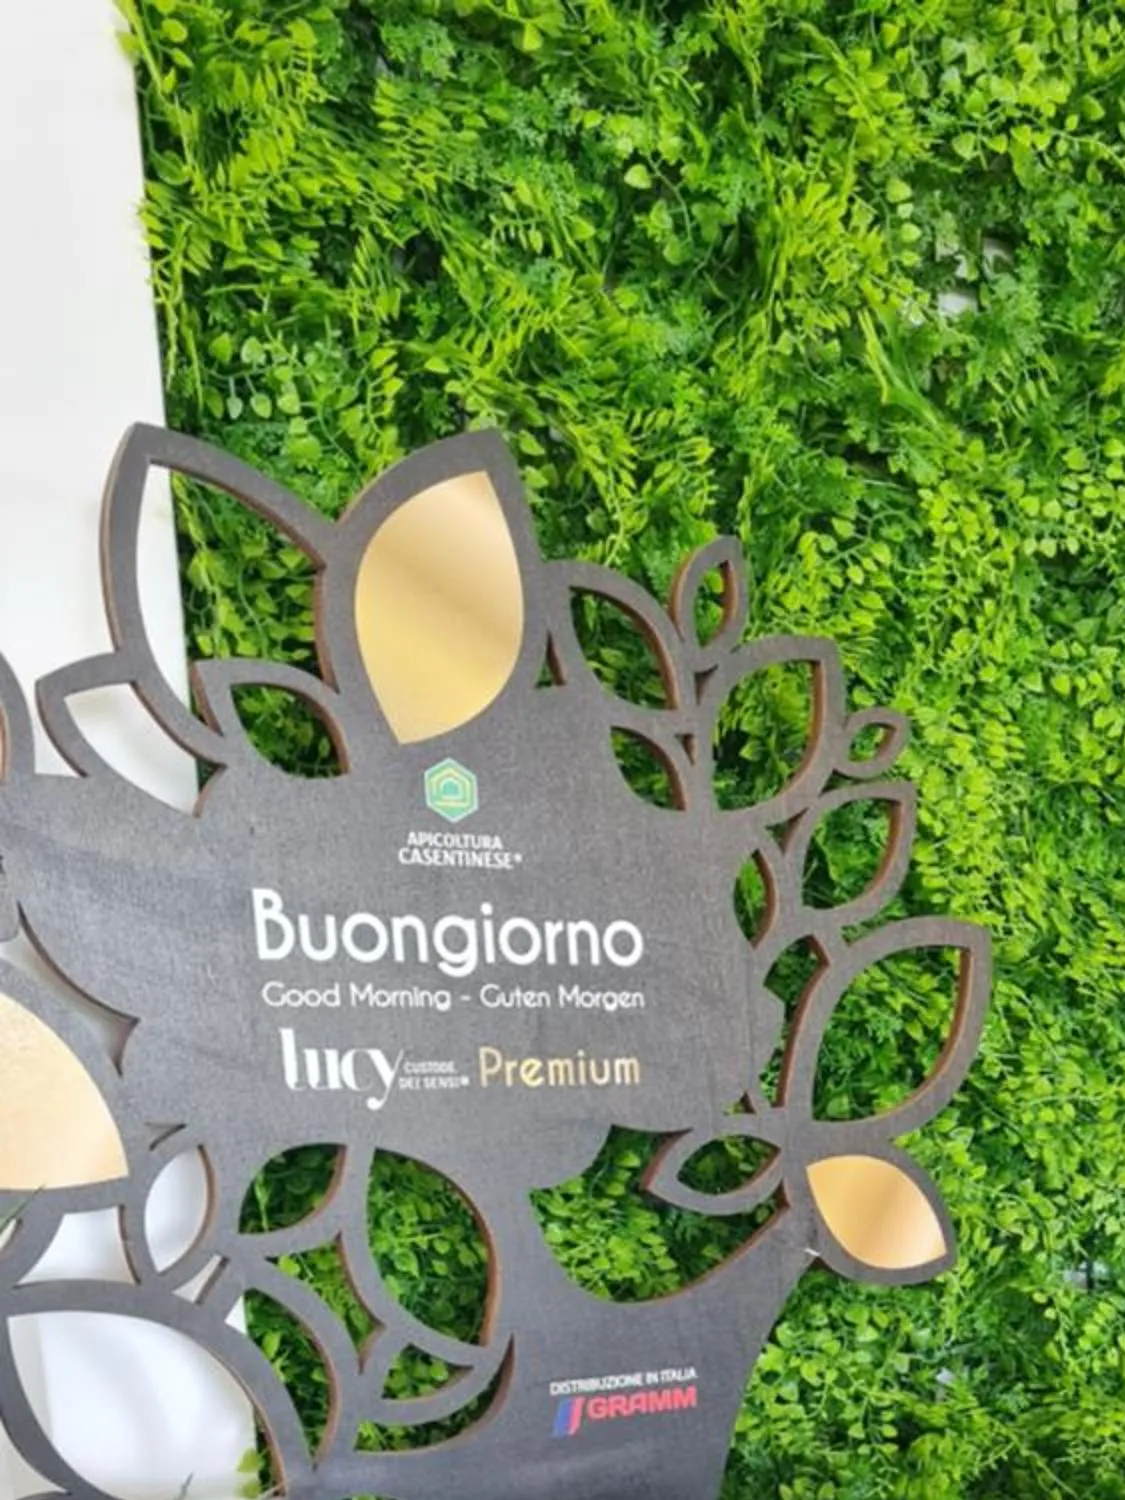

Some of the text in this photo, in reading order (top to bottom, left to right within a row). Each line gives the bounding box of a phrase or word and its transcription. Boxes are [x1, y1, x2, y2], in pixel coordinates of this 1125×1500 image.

[252, 888, 644, 978] Buongiorno
[261, 981, 340, 1008] Good
[351, 982, 451, 1011] Morning
[480, 984, 550, 1008] Guten
[559, 985, 645, 1011] Morgen
[279, 1027, 641, 1110] lucy Premium
[587, 1384, 698, 1421] GRAMM
